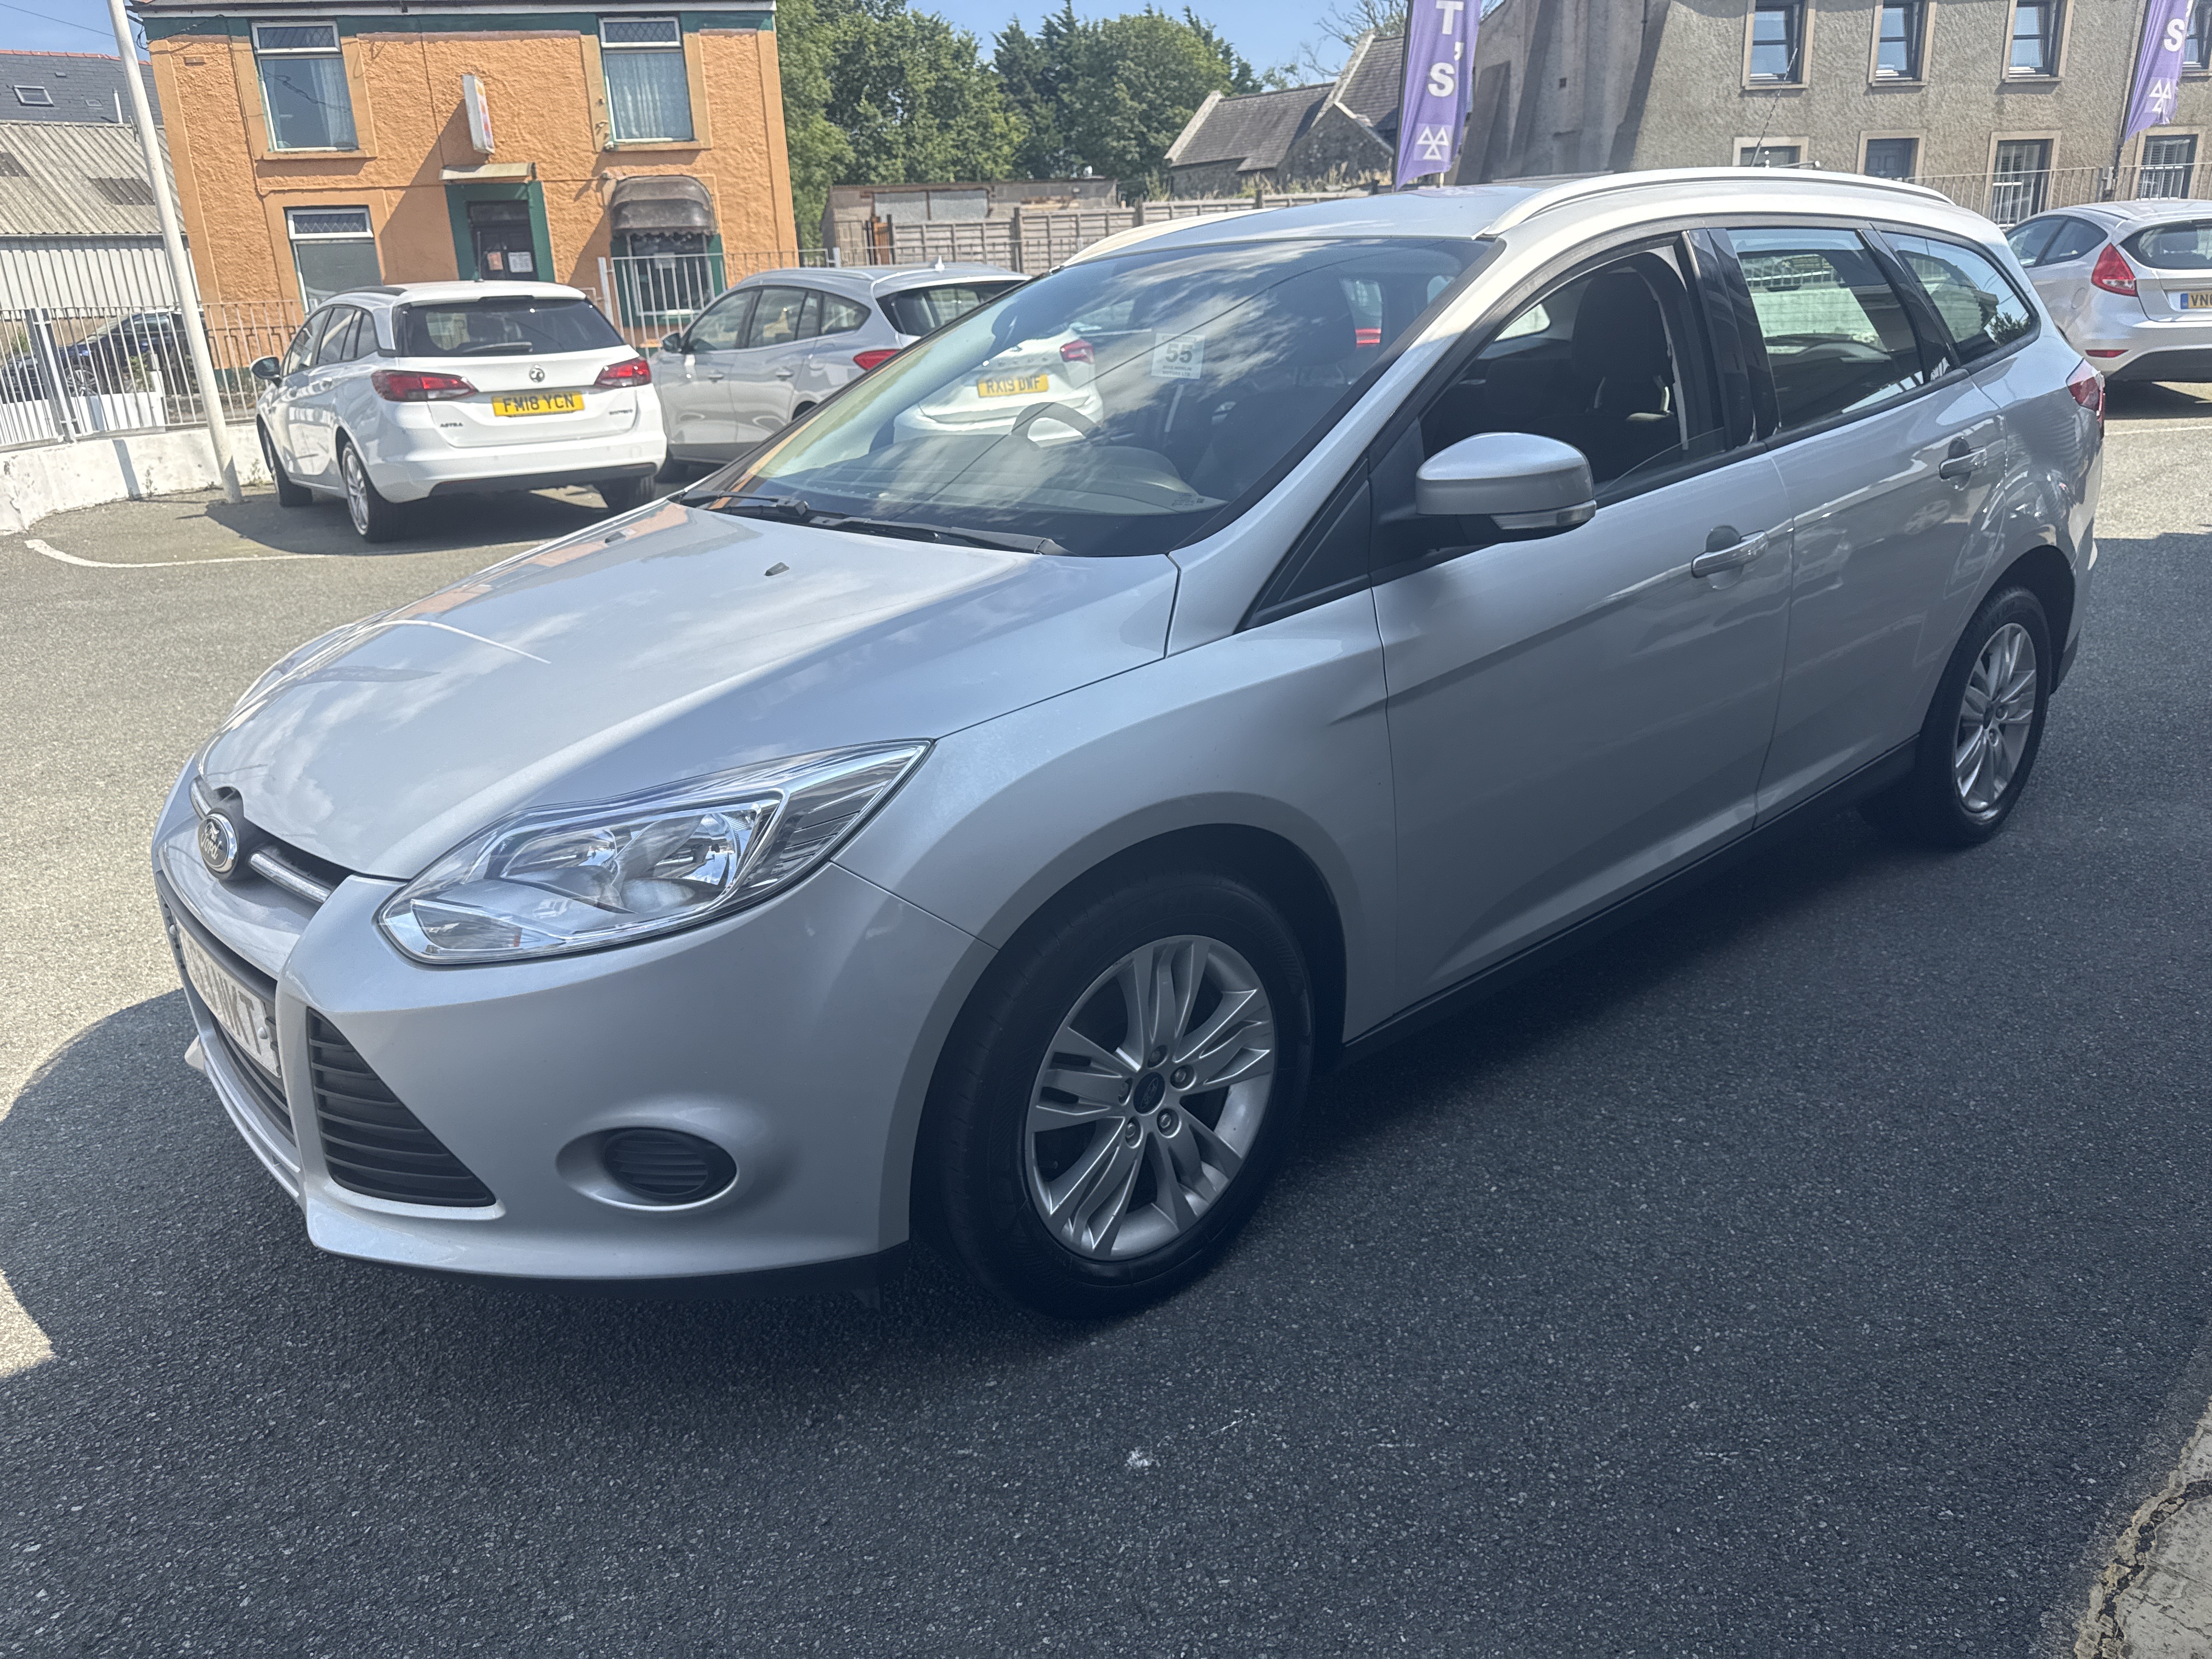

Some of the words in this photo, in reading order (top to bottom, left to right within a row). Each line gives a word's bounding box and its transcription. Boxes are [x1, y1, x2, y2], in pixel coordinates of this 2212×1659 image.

[1166, 343, 1193, 363] 55
[987, 377, 1015, 393] RX19
[503, 396, 540, 413] FM18
[543, 393, 574, 410] YCN
[201, 822, 222, 860] Ford
